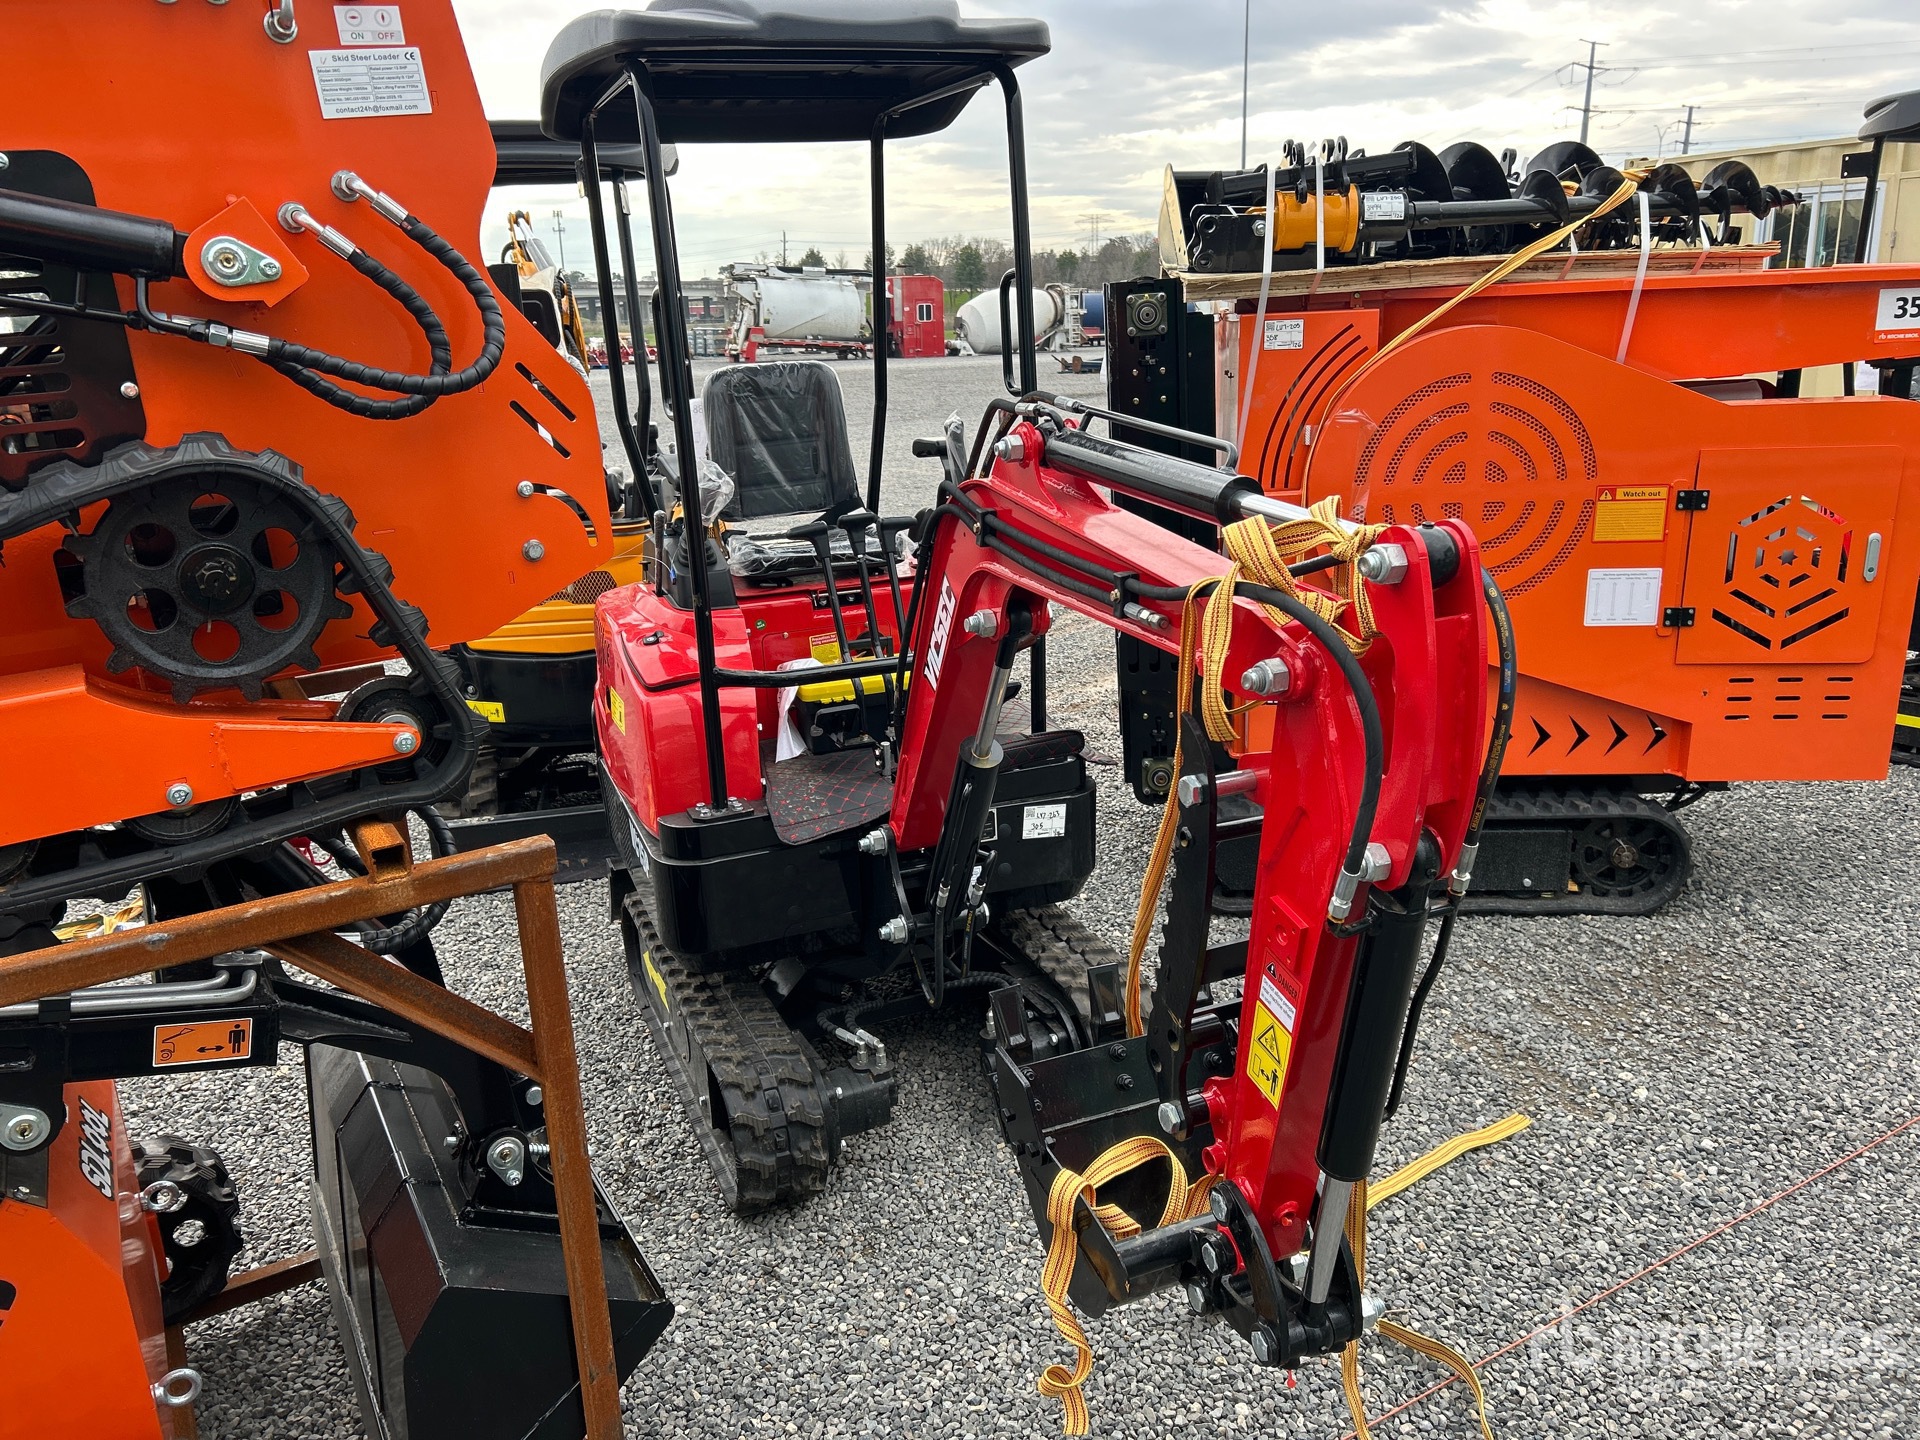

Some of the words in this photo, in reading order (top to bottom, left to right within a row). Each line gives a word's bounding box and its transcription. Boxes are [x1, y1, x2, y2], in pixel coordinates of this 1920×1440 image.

[350, 32, 365, 40] ON
[377, 32, 396, 40] OFF
[331, 54, 350, 63] Skid
[351, 53, 372, 62] Steer
[372, 53, 400, 62] Loader
[335, 103, 419, 114] contact24h@foxmail.com
[1893, 296, 1920, 319] 35
[1622, 490, 1646, 498] Watch
[1647, 490, 1662, 498] out
[1277, 973, 1298, 1000] DANGER
